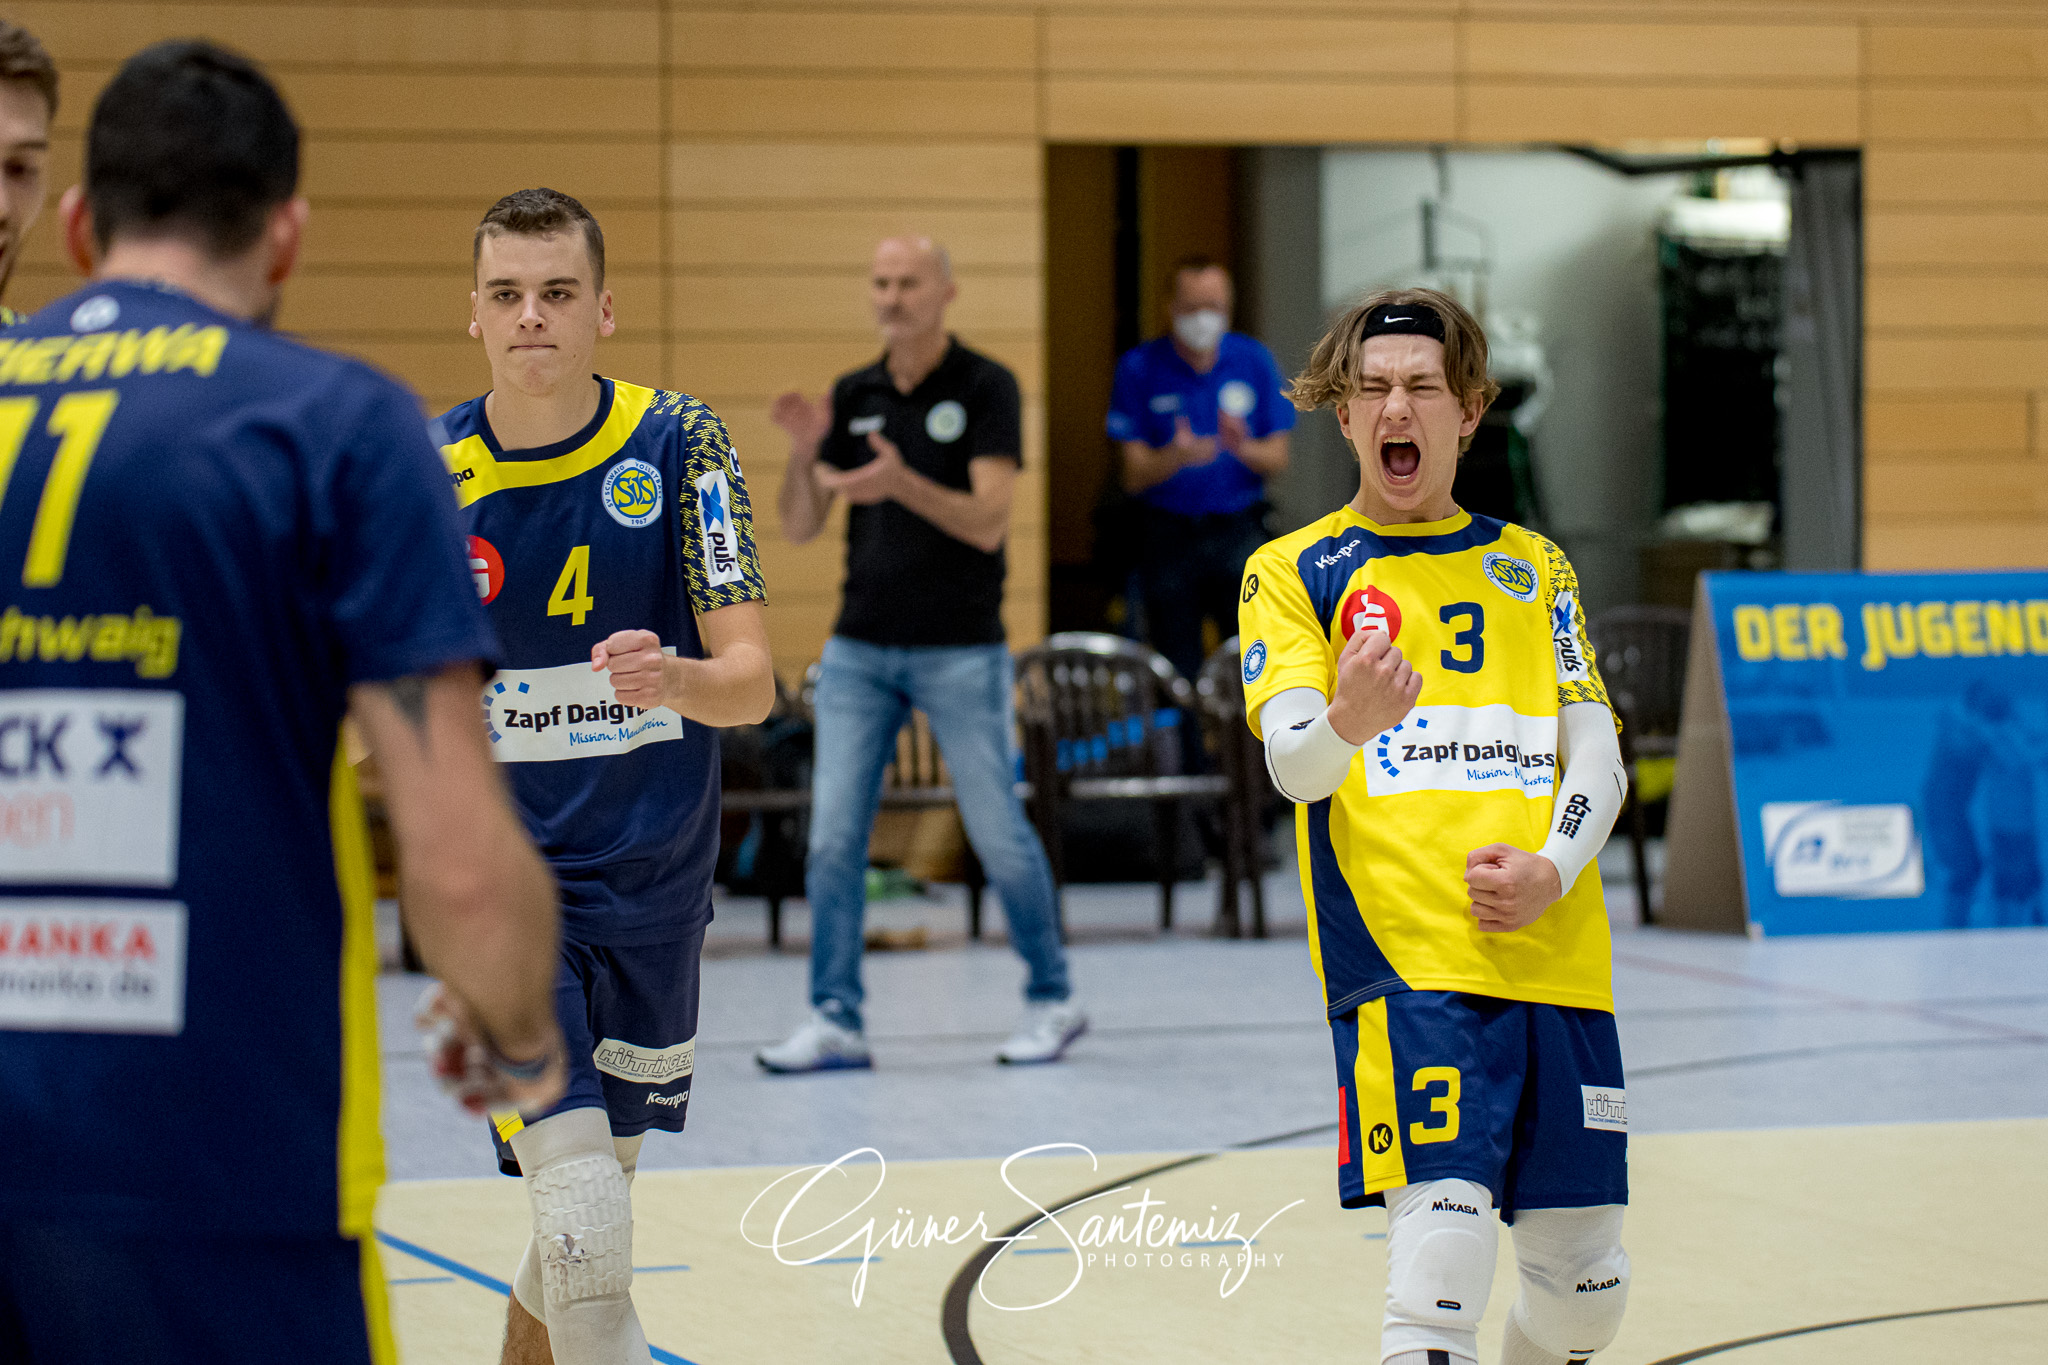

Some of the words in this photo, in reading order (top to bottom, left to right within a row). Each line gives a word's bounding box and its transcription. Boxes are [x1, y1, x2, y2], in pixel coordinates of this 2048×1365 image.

[604, 464, 625, 496] SCHWAIG
[707, 532, 736, 573] puls
[547, 545, 594, 626] 4
[1440, 601, 1485, 673] 3
[1732, 603, 1848, 662] DER
[1553, 637, 1583, 672] puls
[504, 705, 562, 733] Zapf
[569, 731, 617, 746] Mission:
[1401, 741, 1459, 762] Zapf
[1463, 740, 1555, 768] Daiguss
[1466, 768, 1513, 781] Mission:
[645, 1090, 689, 1109] Kempa
[1409, 1066, 1461, 1145] 3
[1431, 1197, 1479, 1216] MIKASA
[1575, 1276, 1621, 1293] MIKASA
